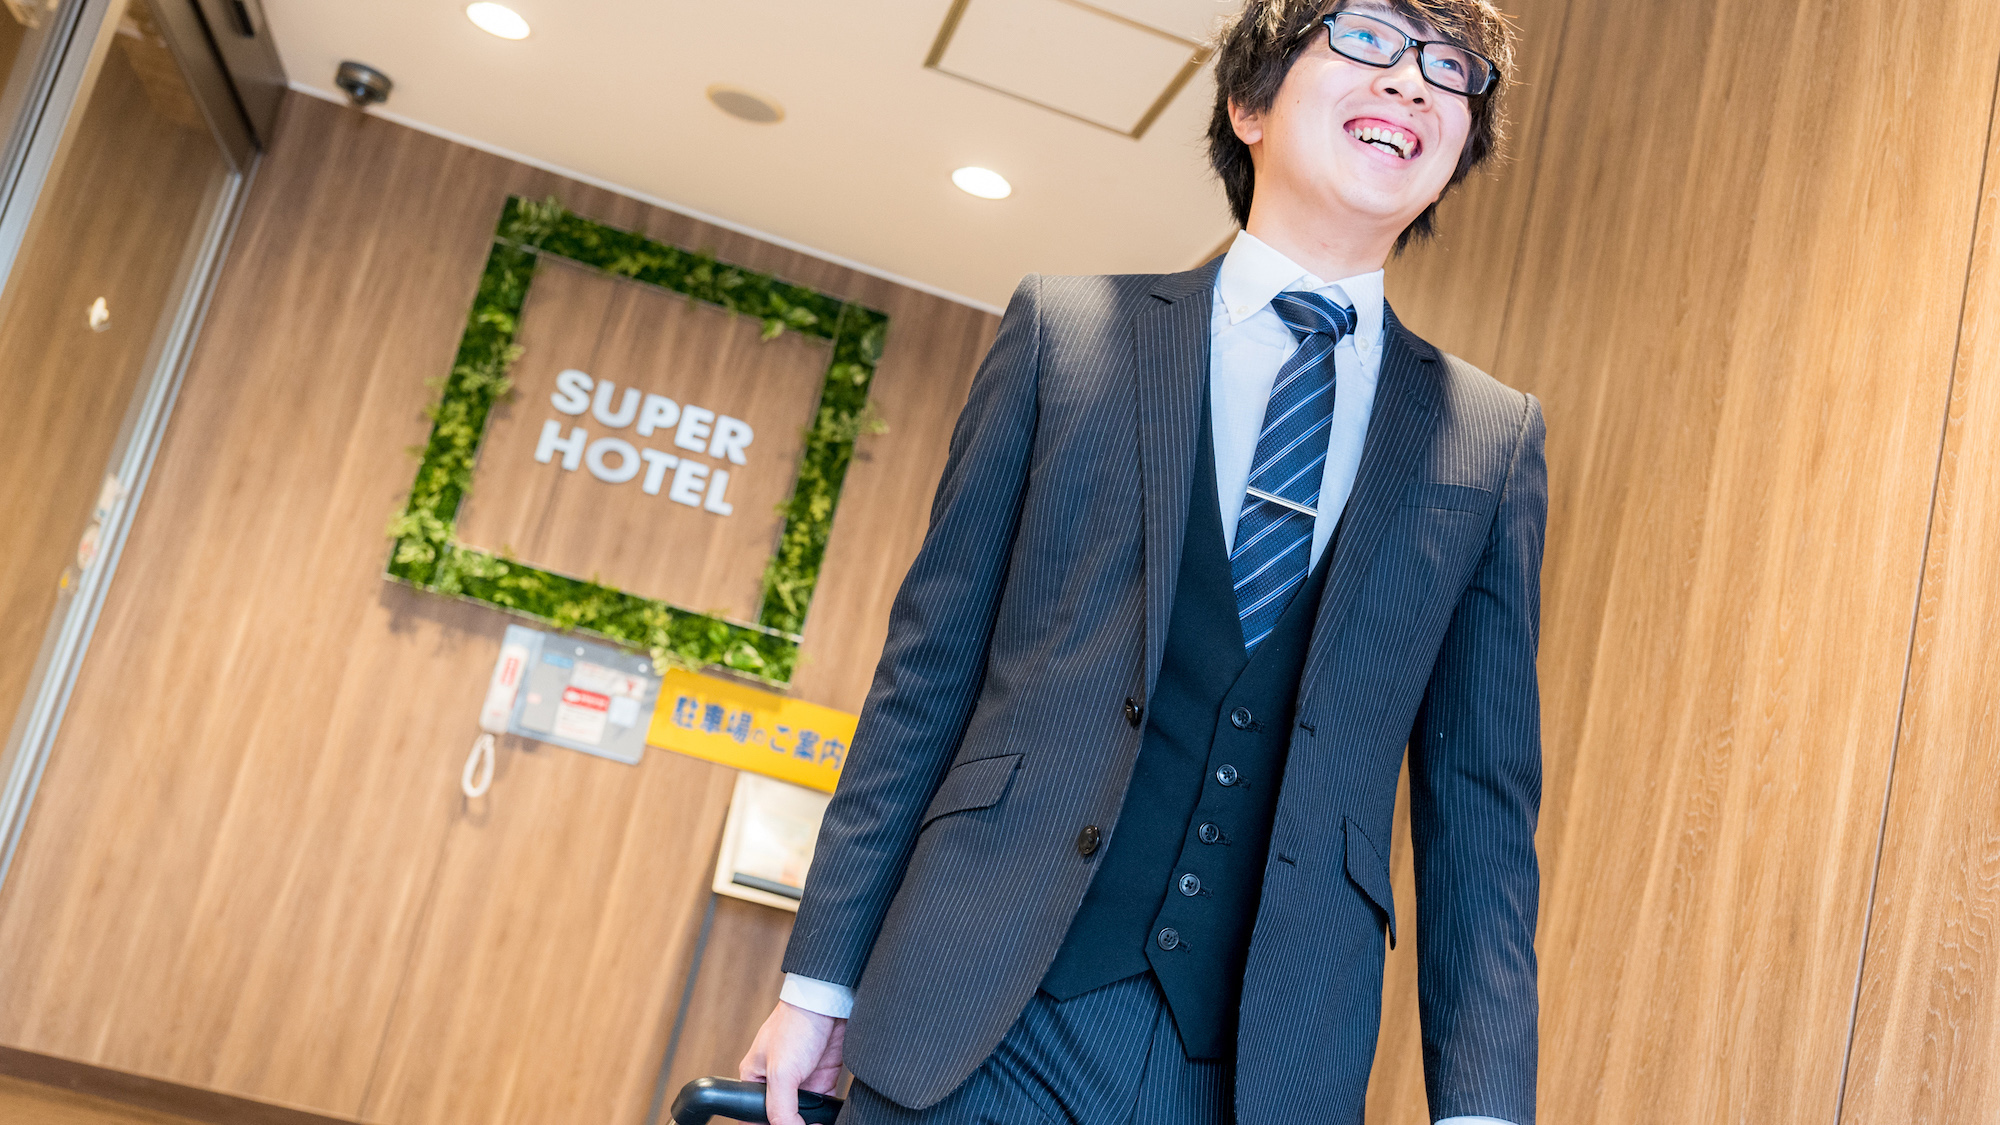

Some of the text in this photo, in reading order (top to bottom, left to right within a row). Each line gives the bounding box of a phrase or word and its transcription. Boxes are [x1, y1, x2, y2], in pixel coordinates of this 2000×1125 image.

[551, 369, 754, 465] SUPER
[534, 419, 733, 516] HOTEL
[672, 696, 846, 770] 駐車場のご案内
